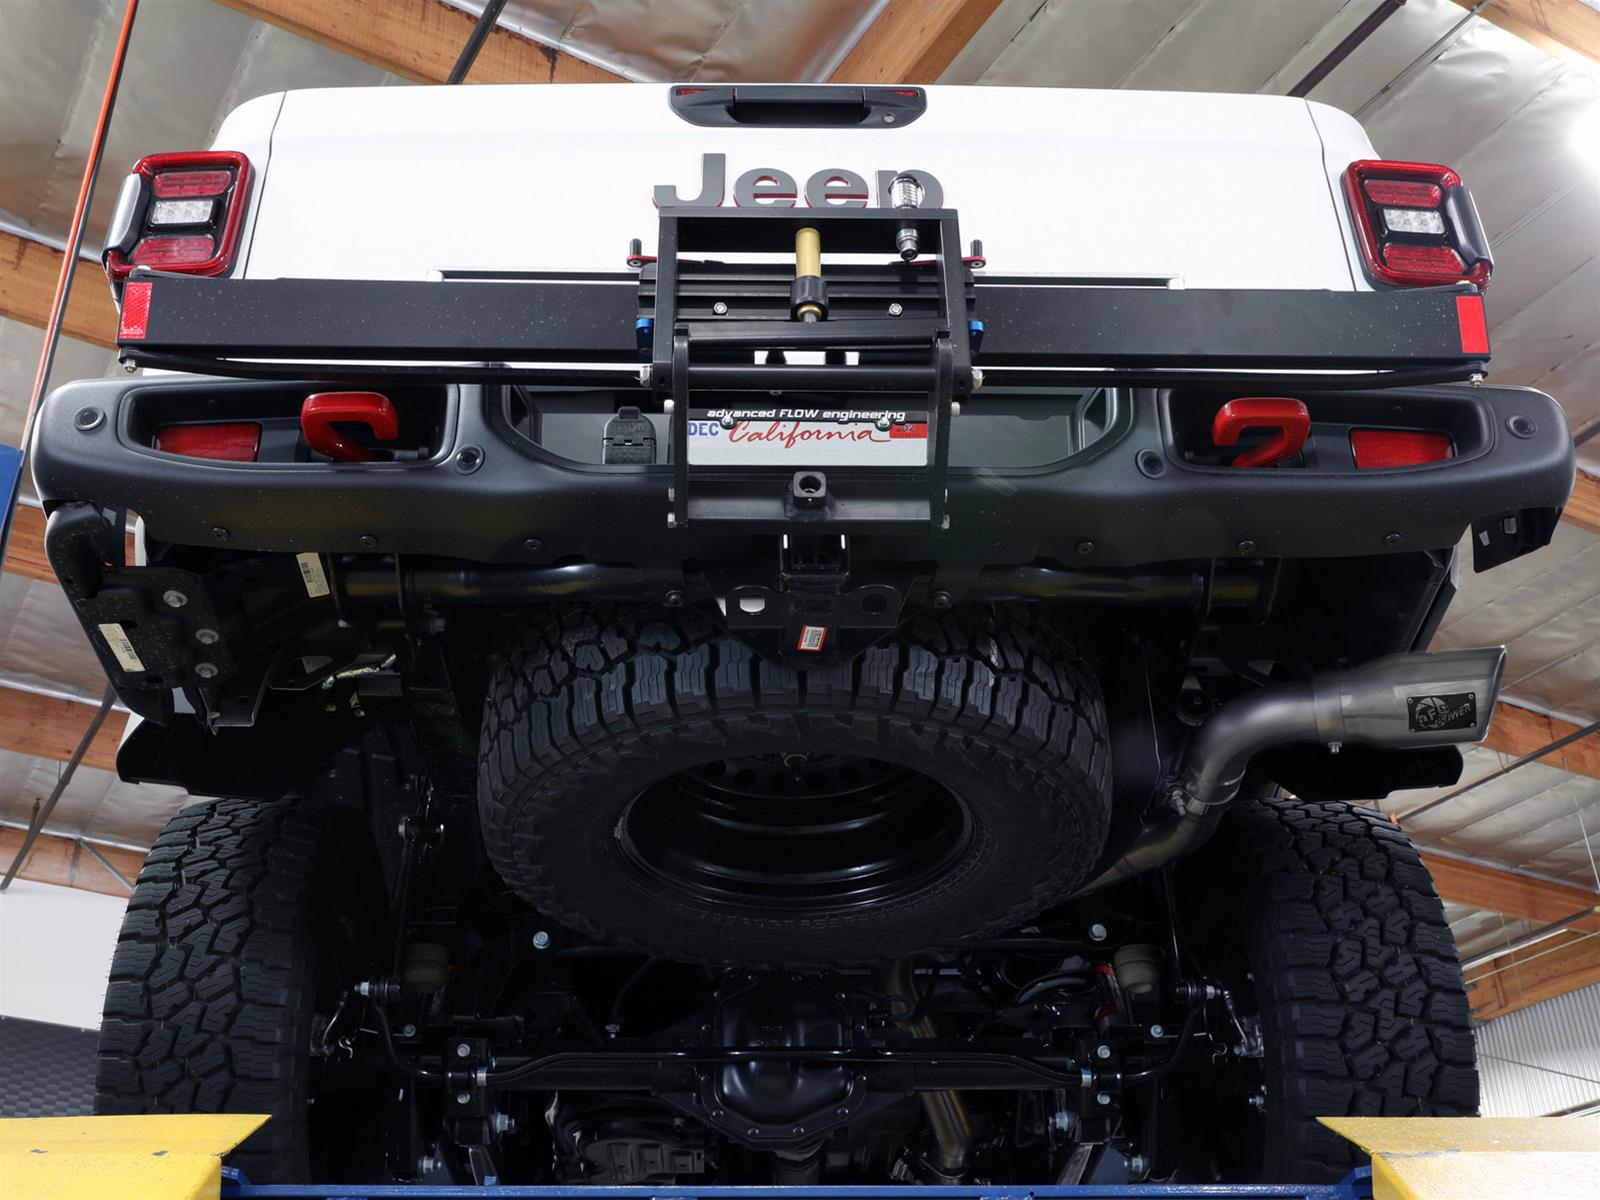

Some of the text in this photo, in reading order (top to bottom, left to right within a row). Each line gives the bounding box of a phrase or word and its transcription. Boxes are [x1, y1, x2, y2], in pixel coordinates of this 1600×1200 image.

[707, 409, 905, 422] advanced FLOW engineering
[688, 422, 719, 436] DEC
[729, 420, 891, 448] California
